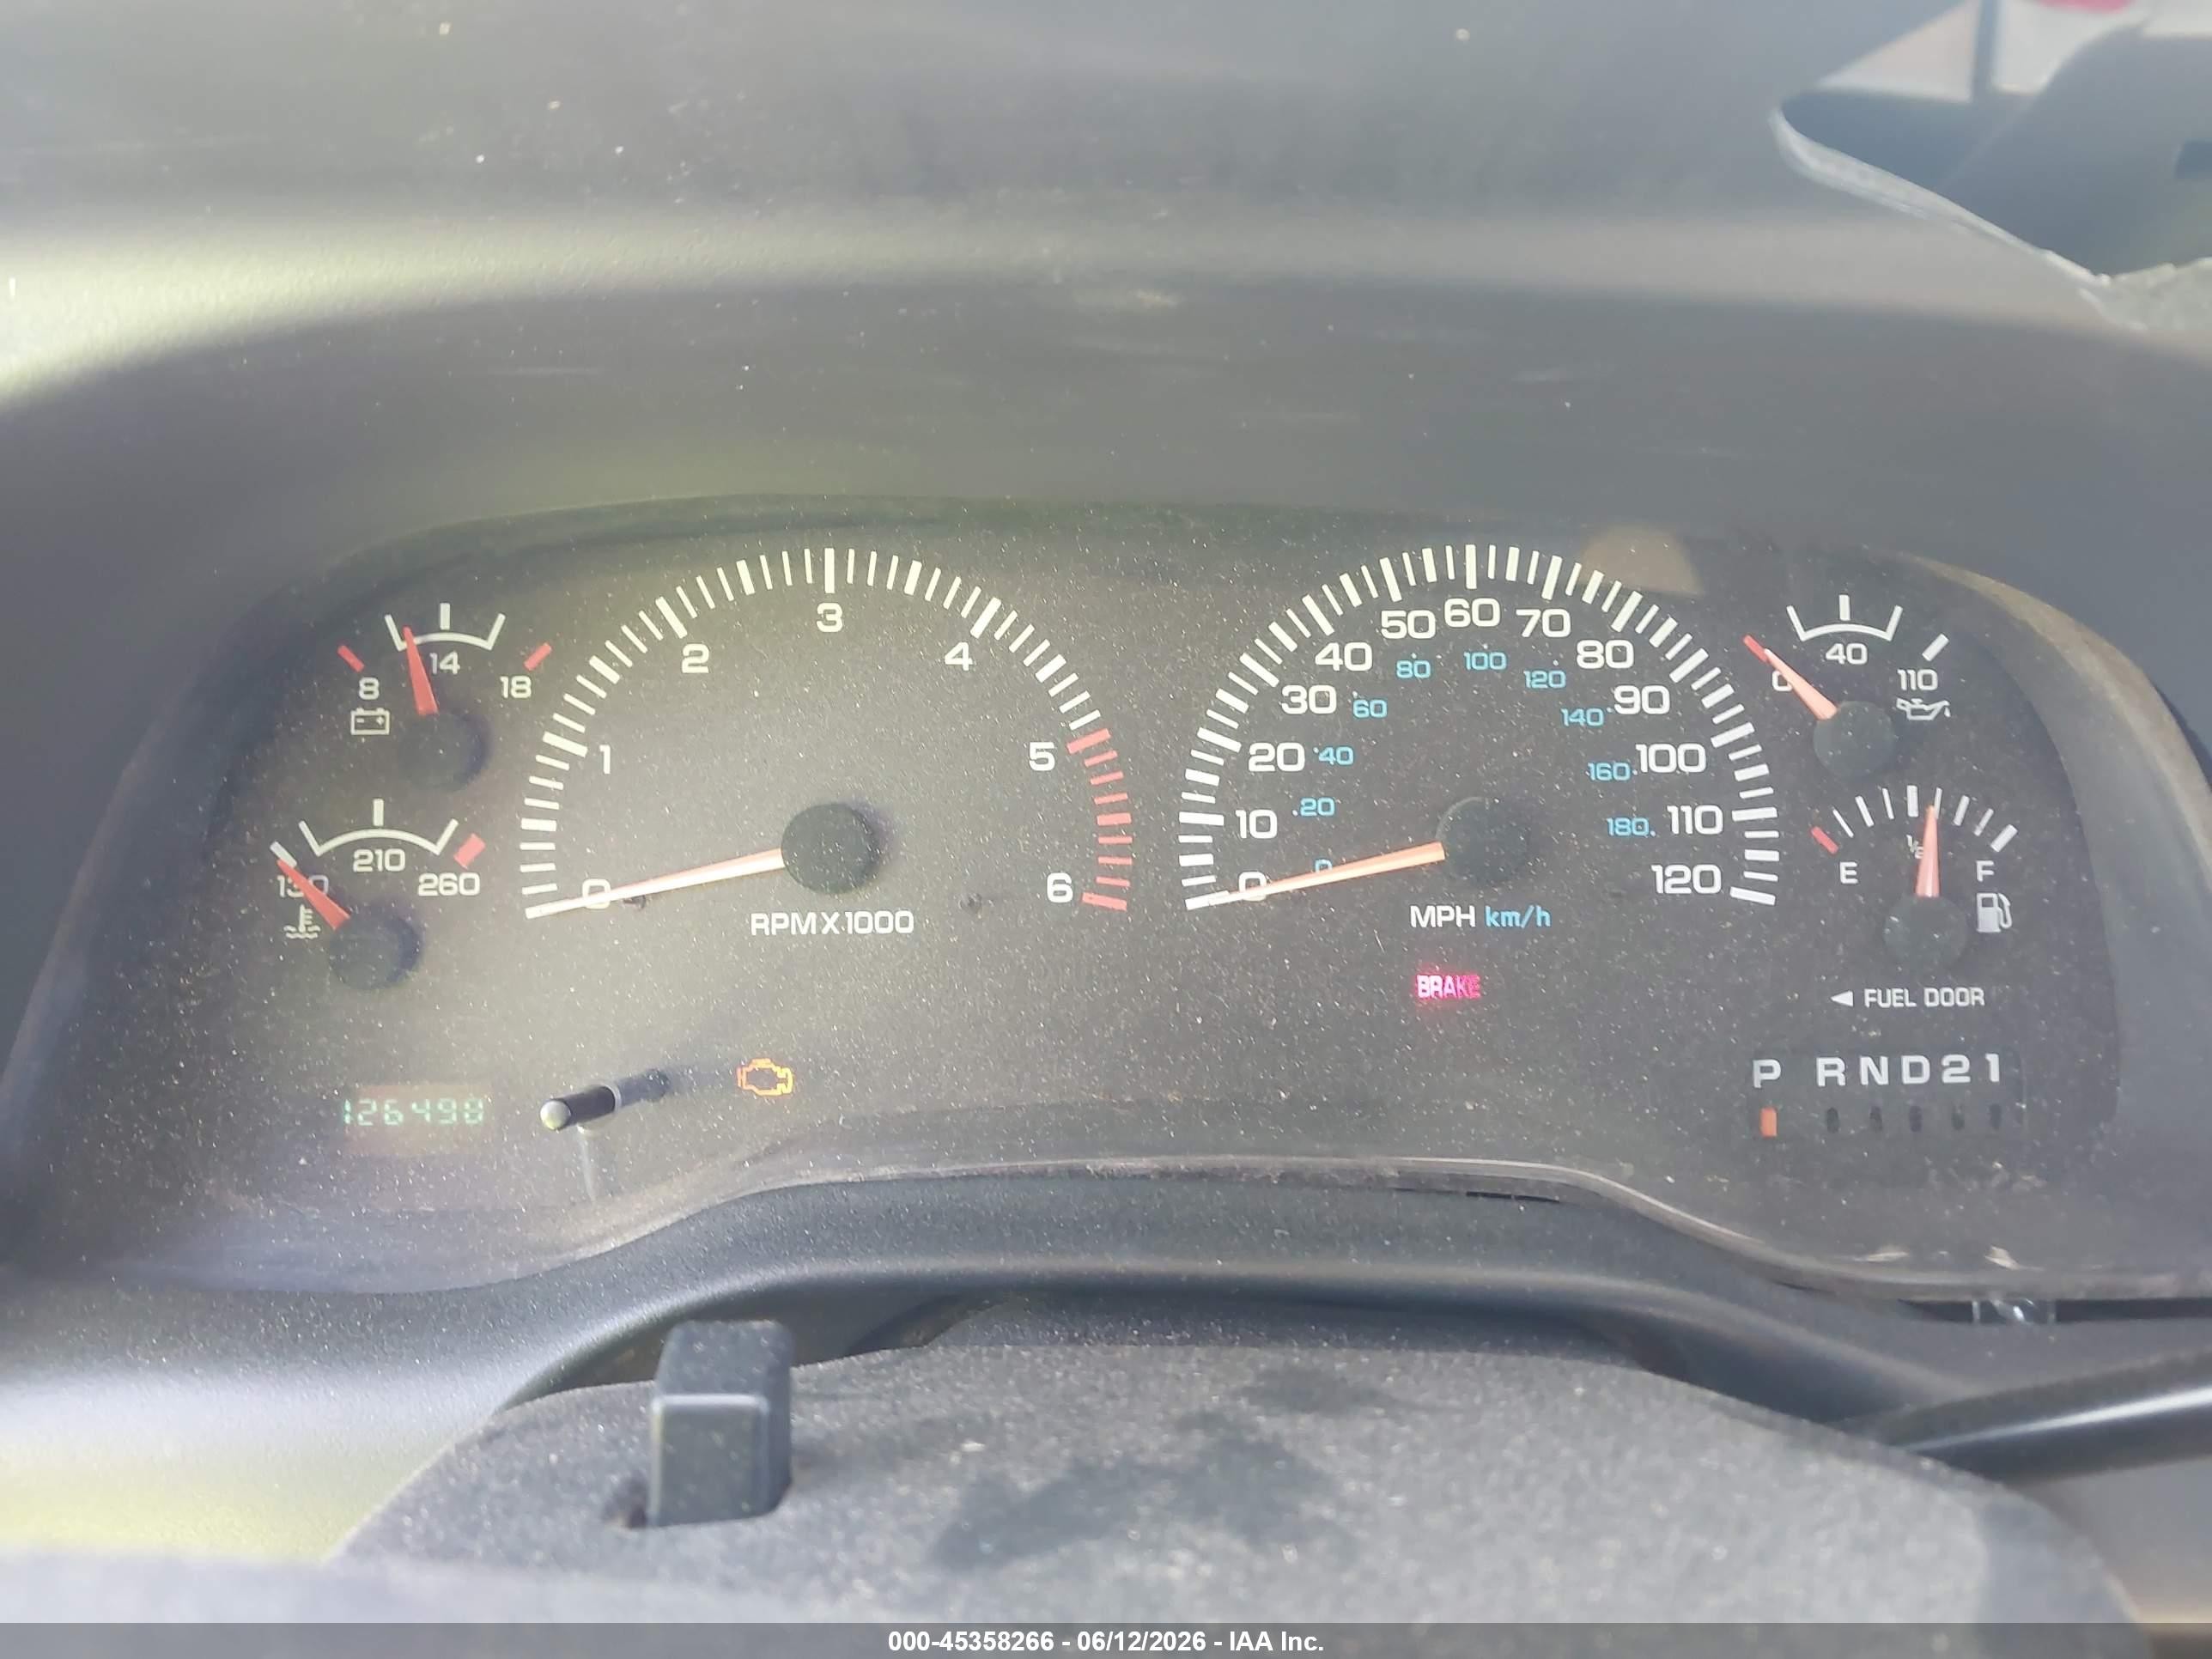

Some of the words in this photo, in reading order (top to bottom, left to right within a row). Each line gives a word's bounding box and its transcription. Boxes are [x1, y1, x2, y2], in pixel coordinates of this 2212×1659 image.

[816, 602, 843, 633] 3
[1381, 610, 1436, 639] 50
[1444, 598, 1501, 628] 60
[1516, 608, 1571, 638] 70
[429, 651, 460, 675] 14
[682, 643, 709, 673] 2
[945, 642, 973, 671] 4
[1315, 642, 1373, 672] 40
[1464, 652, 1506, 671] 100
[1576, 639, 1635, 669] 80
[1825, 642, 1868, 665] 40
[1396, 659, 1431, 679] 80
[1523, 671, 1567, 689] 120
[1897, 668, 1939, 691] 110
[358, 677, 380, 700] 8
[500, 675, 532, 698] 18
[1281, 685, 1337, 714] 30
[1613, 685, 1670, 714] 90
[1352, 700, 1388, 719] 60
[1560, 708, 1605, 726] 140
[599, 744, 611, 774] 1
[1029, 741, 1055, 771] 5
[1248, 742, 1305, 772] 20
[1318, 746, 1354, 765] 40
[1635, 743, 1706, 773] 100
[1588, 762, 1632, 781] 160
[1299, 797, 1335, 817] 20
[1667, 805, 1723, 835] 110
[1235, 809, 1278, 839] 10
[1607, 817, 1650, 836] 180
[353, 848, 405, 872] 210
[1839, 861, 1858, 884] E
[1976, 860, 1995, 882] F
[417, 872, 480, 896] 260
[1046, 872, 1073, 903] 6
[1238, 871, 1267, 902] 0
[1650, 864, 1722, 894] 120
[582, 878, 611, 909] 0
[1409, 905, 1476, 928] MPH
[1485, 905, 1552, 928] km/h
[1416, 975, 1480, 999] BRAKE
[1864, 988, 1917, 1008] FUEL
[1923, 988, 1985, 1007] DOOR
[1752, 1059, 1782, 1088] P
[1816, 1056, 1846, 1087] R
[1859, 1055, 1889, 1086] N
[1901, 1054, 1931, 1085] D
[1941, 1054, 1972, 1084] 2
[1984, 1053, 2000, 1083] 1
